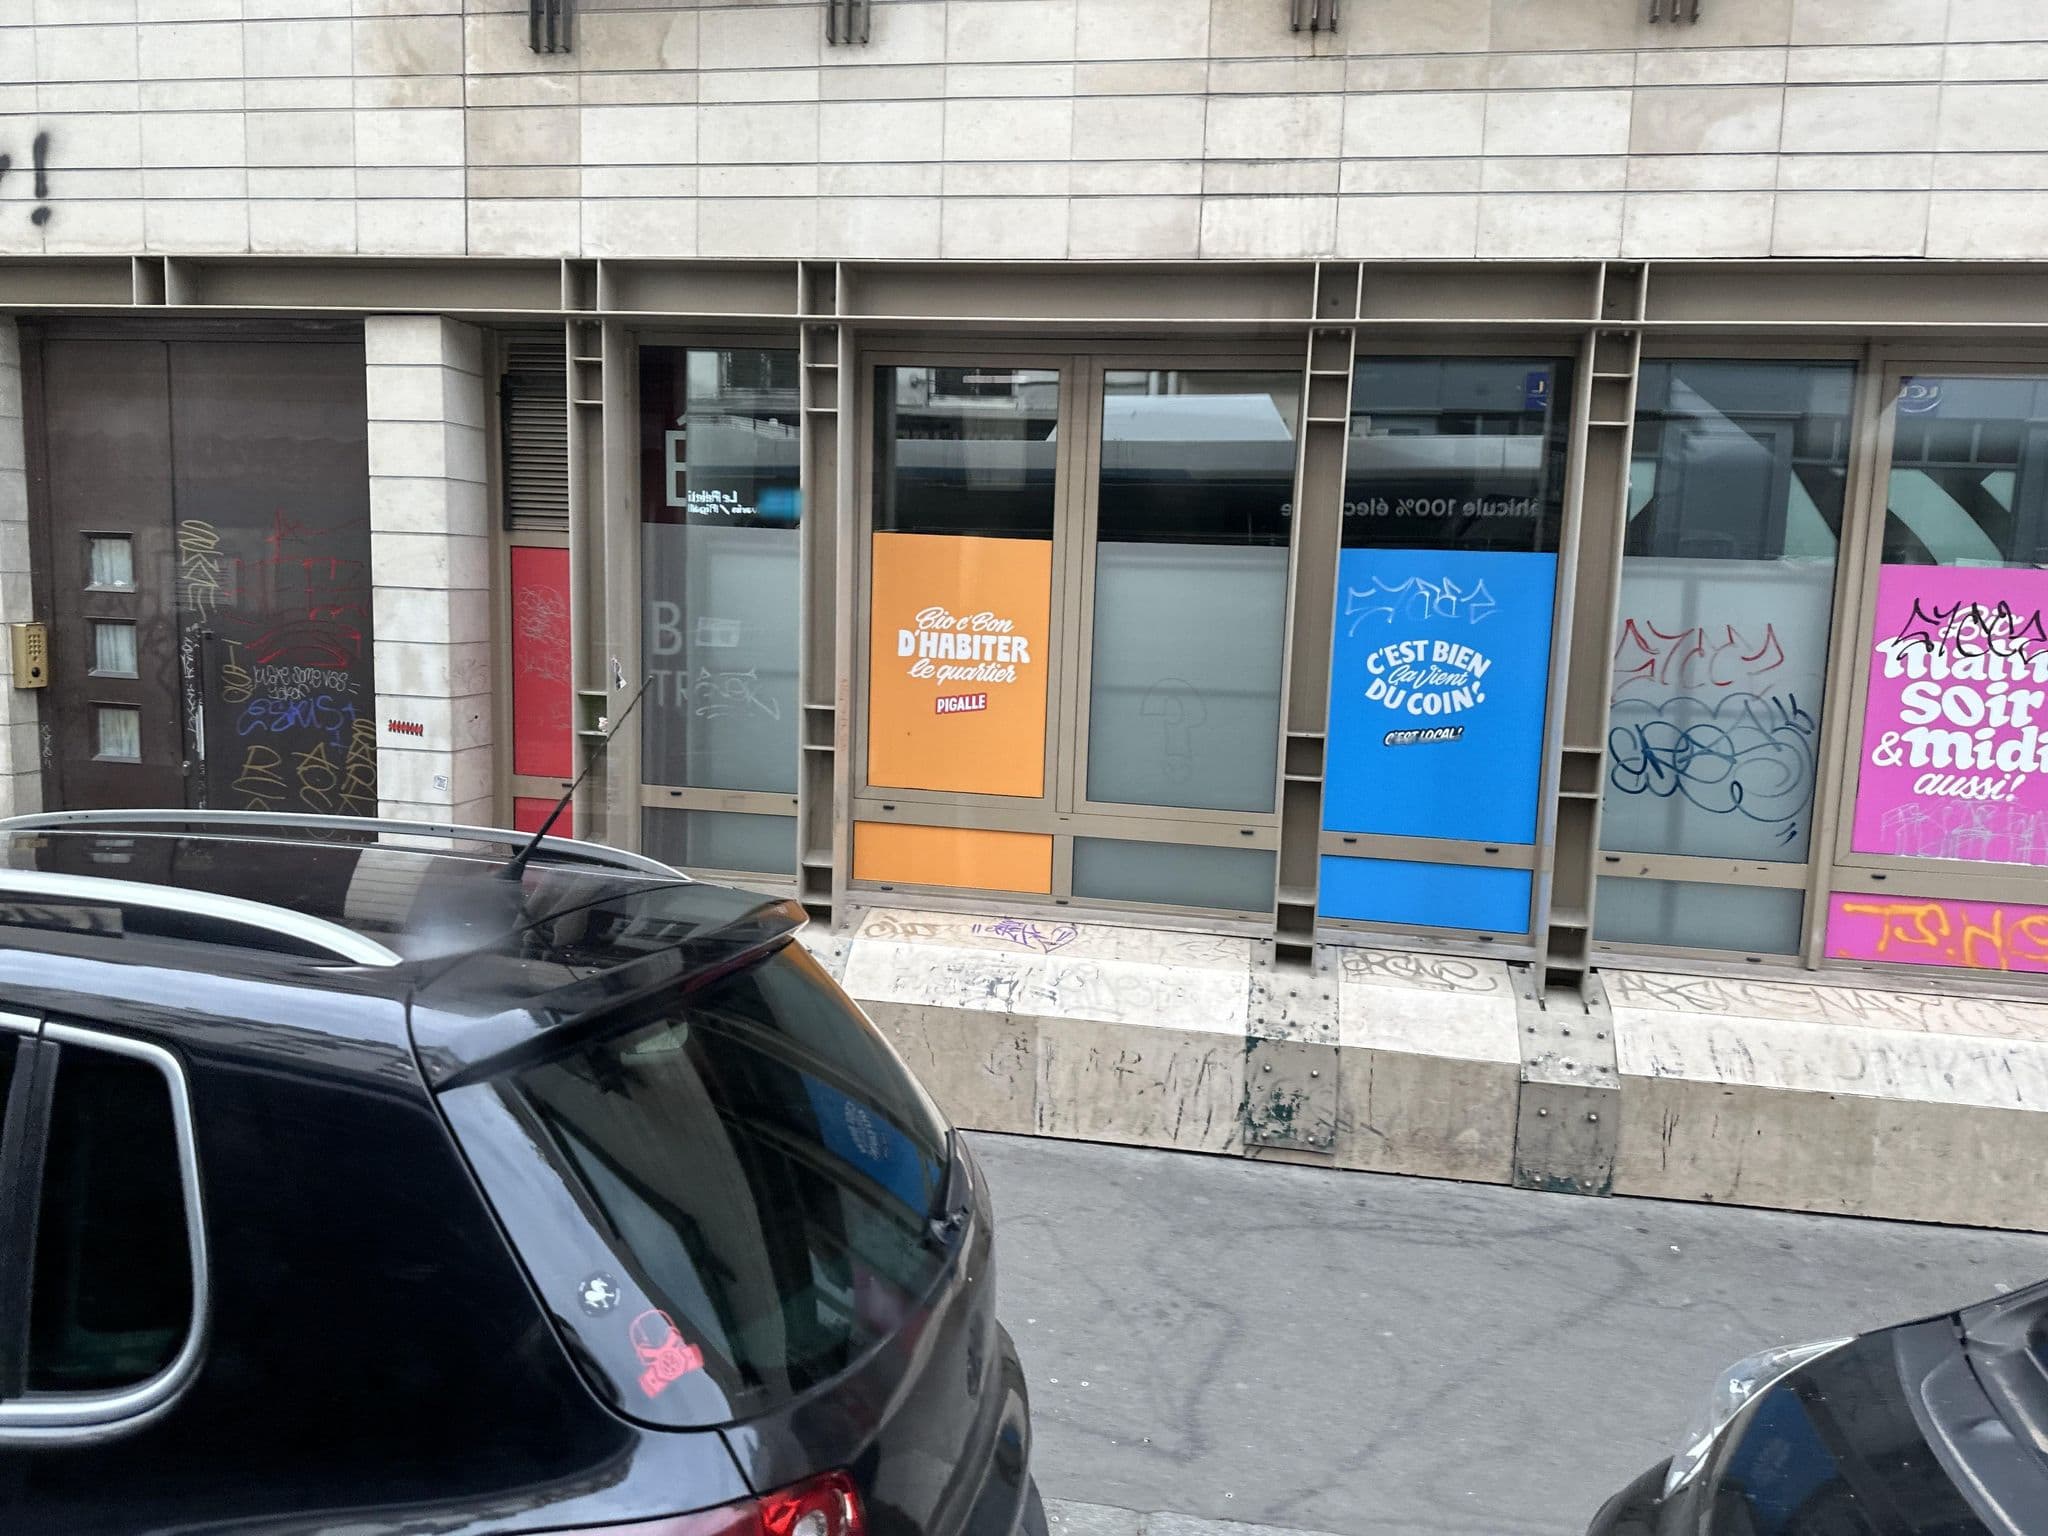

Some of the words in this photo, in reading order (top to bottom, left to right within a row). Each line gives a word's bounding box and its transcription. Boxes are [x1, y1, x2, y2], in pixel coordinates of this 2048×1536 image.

[915, 606, 956, 630] Bio
[898, 629, 1031, 663] D'HABITER
[1366, 640, 1429, 675] C'EST
[1432, 640, 1492, 678] BIEN
[907, 658, 936, 679] le
[936, 662, 1017, 686] quartier
[936, 694, 987, 713] PIGALLE
[1365, 677, 1407, 709] DU
[1406, 681, 1485, 715] COIN!
[1900, 681, 2045, 727] soir
[1913, 773, 2026, 802] aussi!
